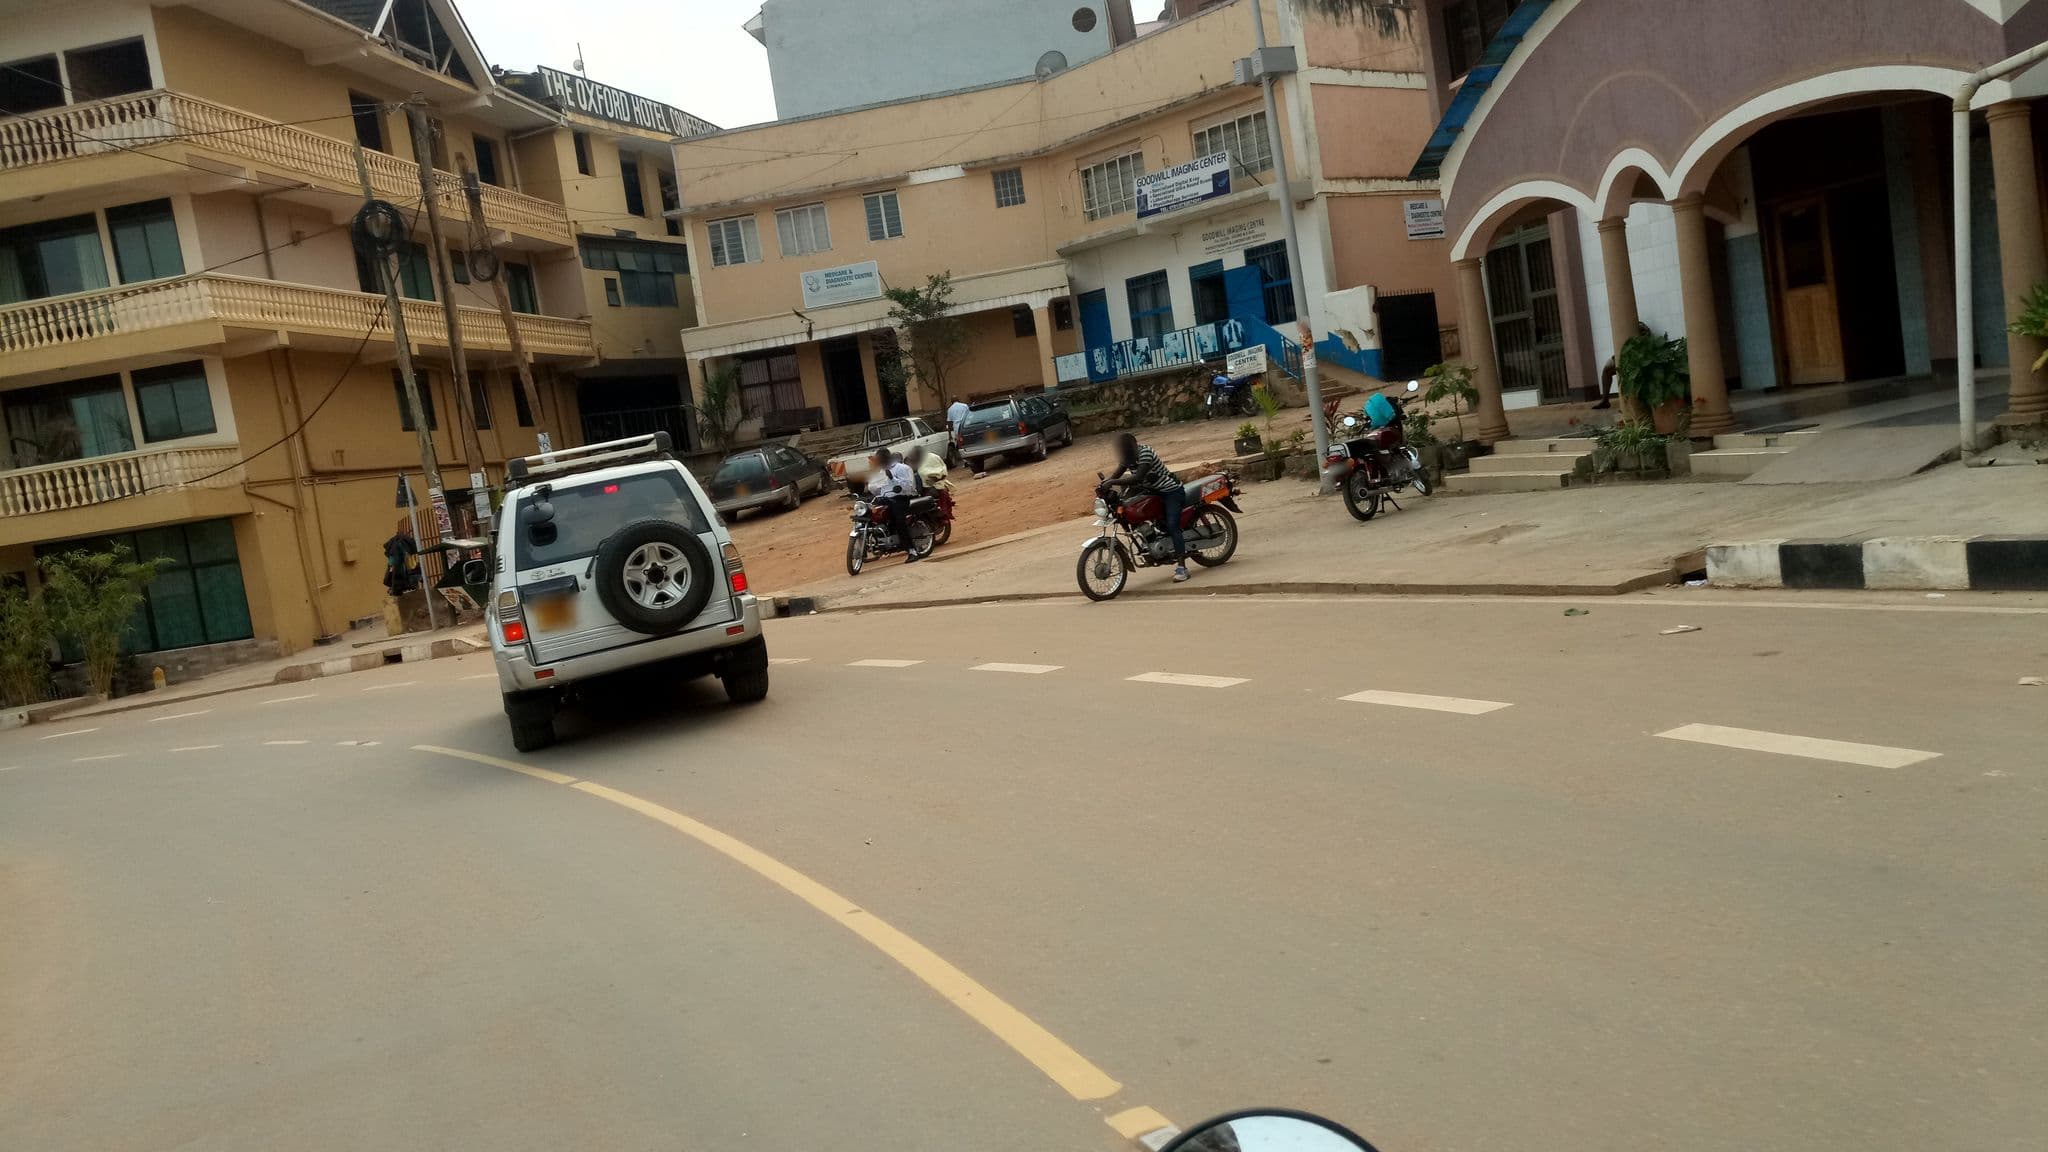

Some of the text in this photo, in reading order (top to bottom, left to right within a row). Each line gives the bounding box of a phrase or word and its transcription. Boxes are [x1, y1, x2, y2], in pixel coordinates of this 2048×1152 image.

[541, 68, 575, 107] THE
[575, 79, 631, 122] OXFORD
[632, 95, 671, 132] HOTEL
[1137, 152, 1228, 187] GOODWILL IMAGING CENTER
[1202, 229, 1226, 242] GOODWILL
[1227, 223, 1247, 235] IMAGING
[1247, 218, 1265, 230] CENTRE
[824, 270, 849, 278] MEDCARE
[825, 271, 873, 285] DIAGNOSTIC CENTRE
[1228, 352, 1246, 362] GOODWILL
[1234, 355, 1257, 366] CENTRE
